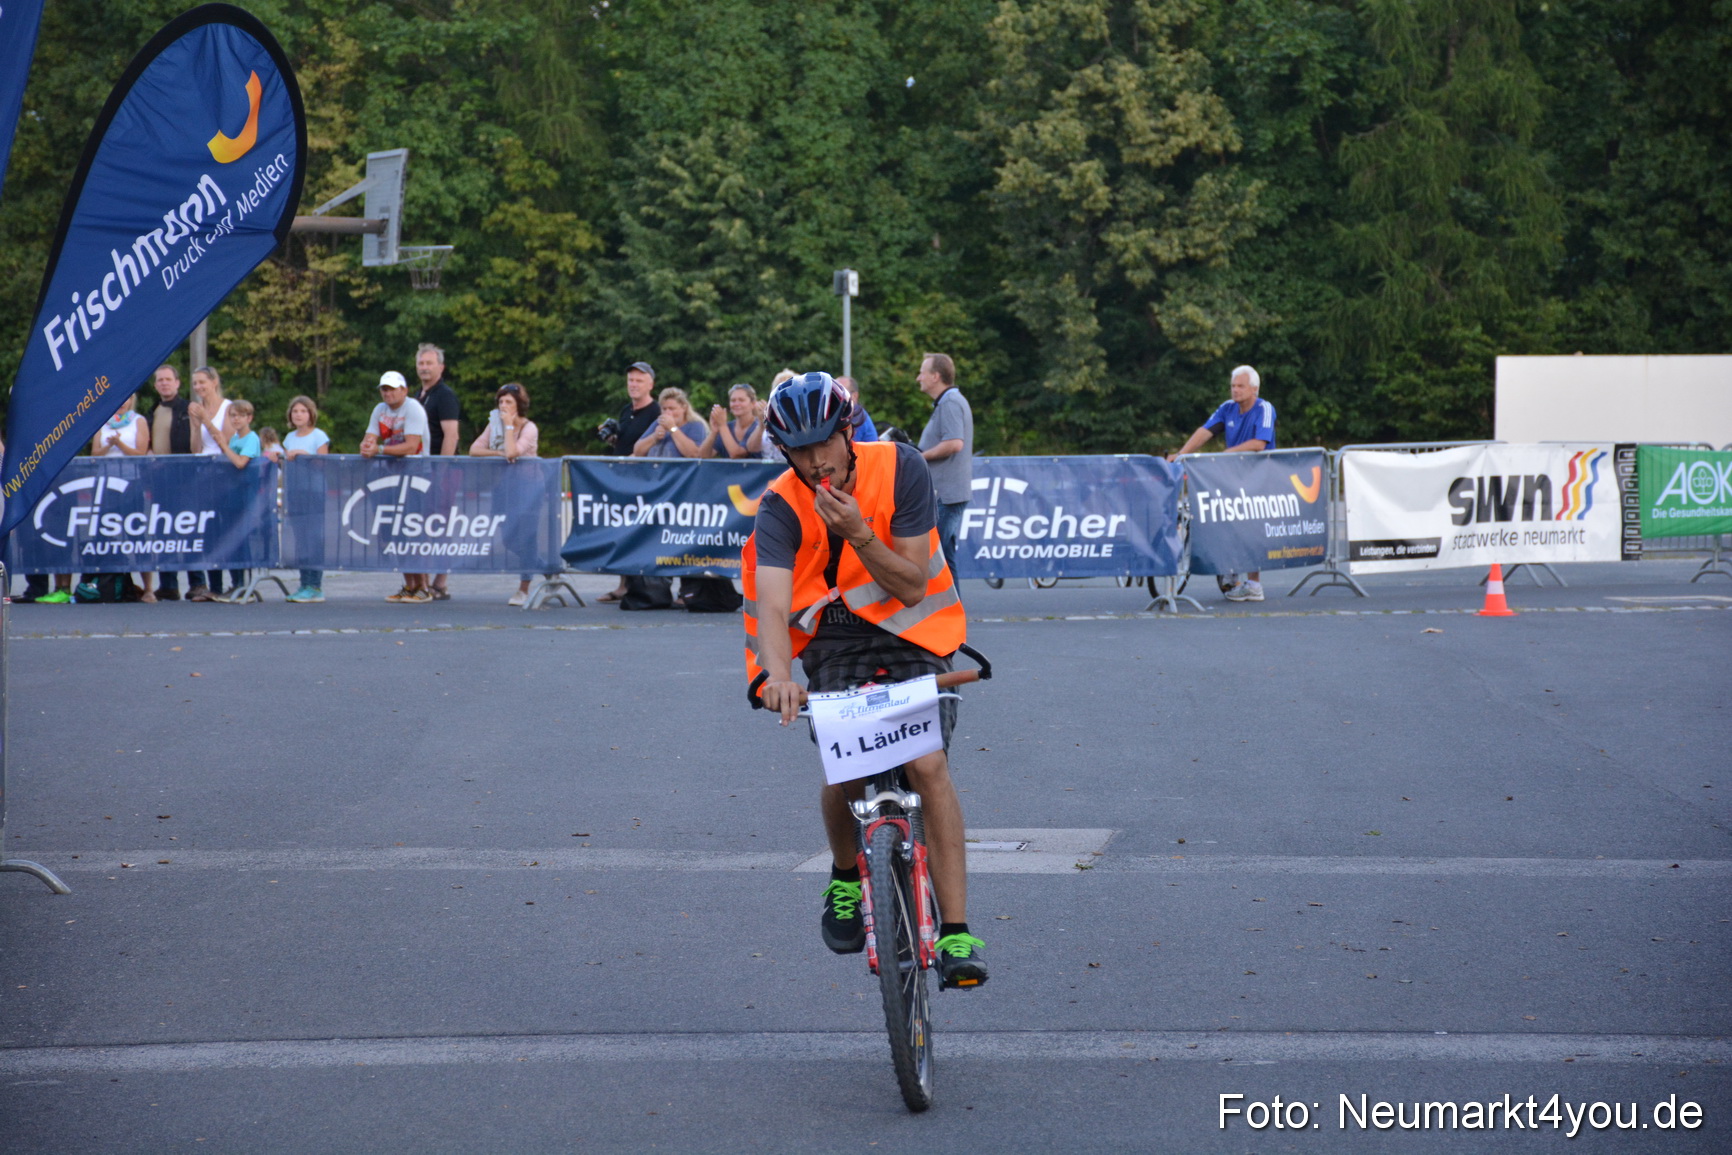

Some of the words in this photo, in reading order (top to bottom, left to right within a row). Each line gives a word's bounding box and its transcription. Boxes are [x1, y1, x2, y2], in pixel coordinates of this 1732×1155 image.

[161, 236, 206, 290] Druck
[205, 208, 234, 245] und
[236, 153, 289, 221] Medien
[43, 173, 228, 371] Frischmann
[1655, 460, 1732, 505] AOK
[577, 493, 729, 528] Frischmann
[1196, 487, 1301, 523] Frischmann
[1447, 473, 1553, 527] swn
[1652, 508, 1667, 519] Die
[66, 503, 216, 537] Fischer
[370, 504, 507, 538] Fischer
[959, 506, 1126, 541] Fischer
[1265, 521, 1287, 538] Druck
[1288, 520, 1302, 536] und
[82, 539, 204, 556] AUTOMOBILE
[383, 541, 491, 556] AUTOMOBILE
[661, 528, 696, 545] Druck
[697, 530, 724, 546] und
[727, 531, 748, 547] Me
[974, 543, 1114, 560] AUTOMOBILE
[1452, 528, 1519, 551] stadtwerke
[1523, 527, 1586, 546] neumarkt
[655, 553, 742, 569] www.frischmann
[830, 741, 852, 759] 1.
[858, 720, 932, 753] Läufer
